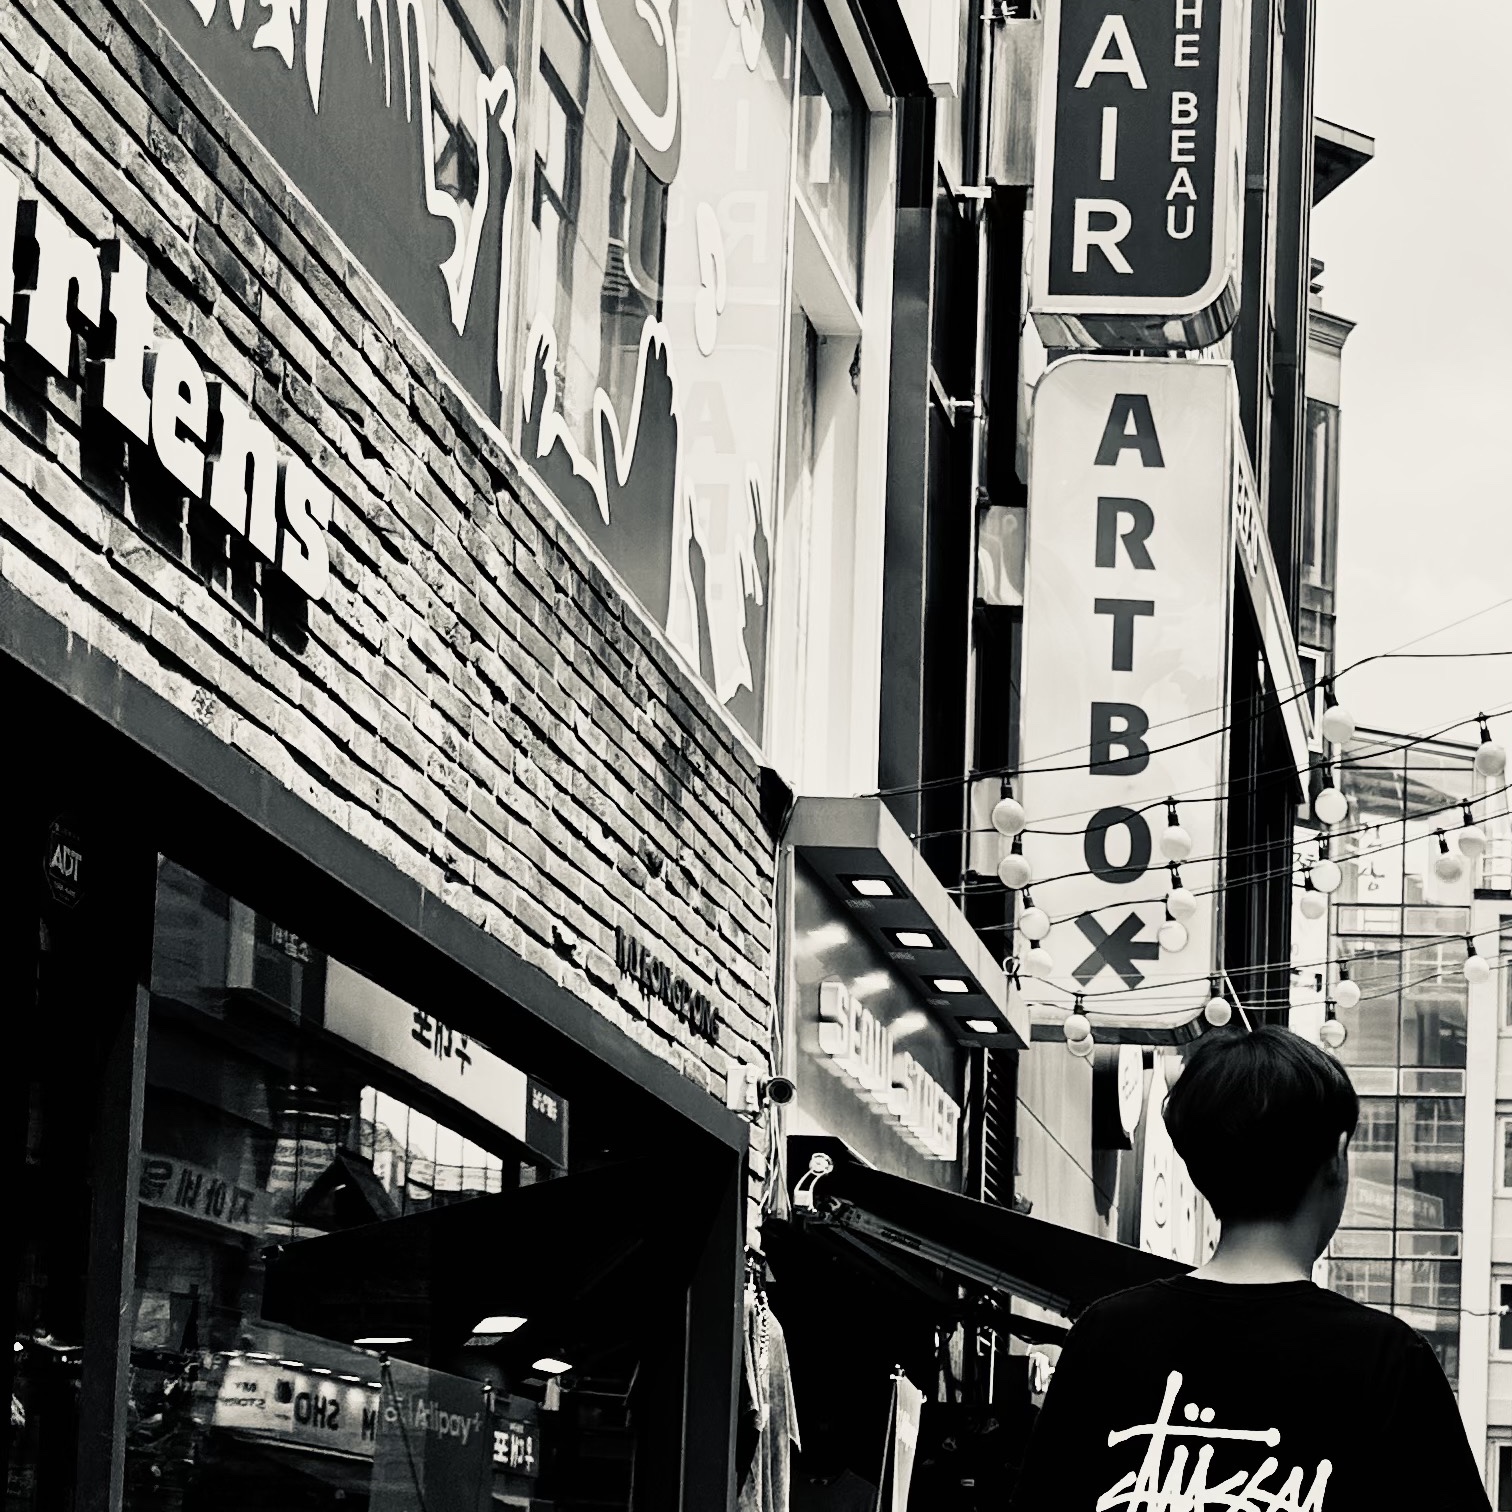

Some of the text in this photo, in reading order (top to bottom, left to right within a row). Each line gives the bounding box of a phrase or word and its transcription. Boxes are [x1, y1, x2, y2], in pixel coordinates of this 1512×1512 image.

[1165, 91, 1199, 240] BEAU
[0, 160, 330, 600] rtens
[49, 843, 82, 882] ADT
